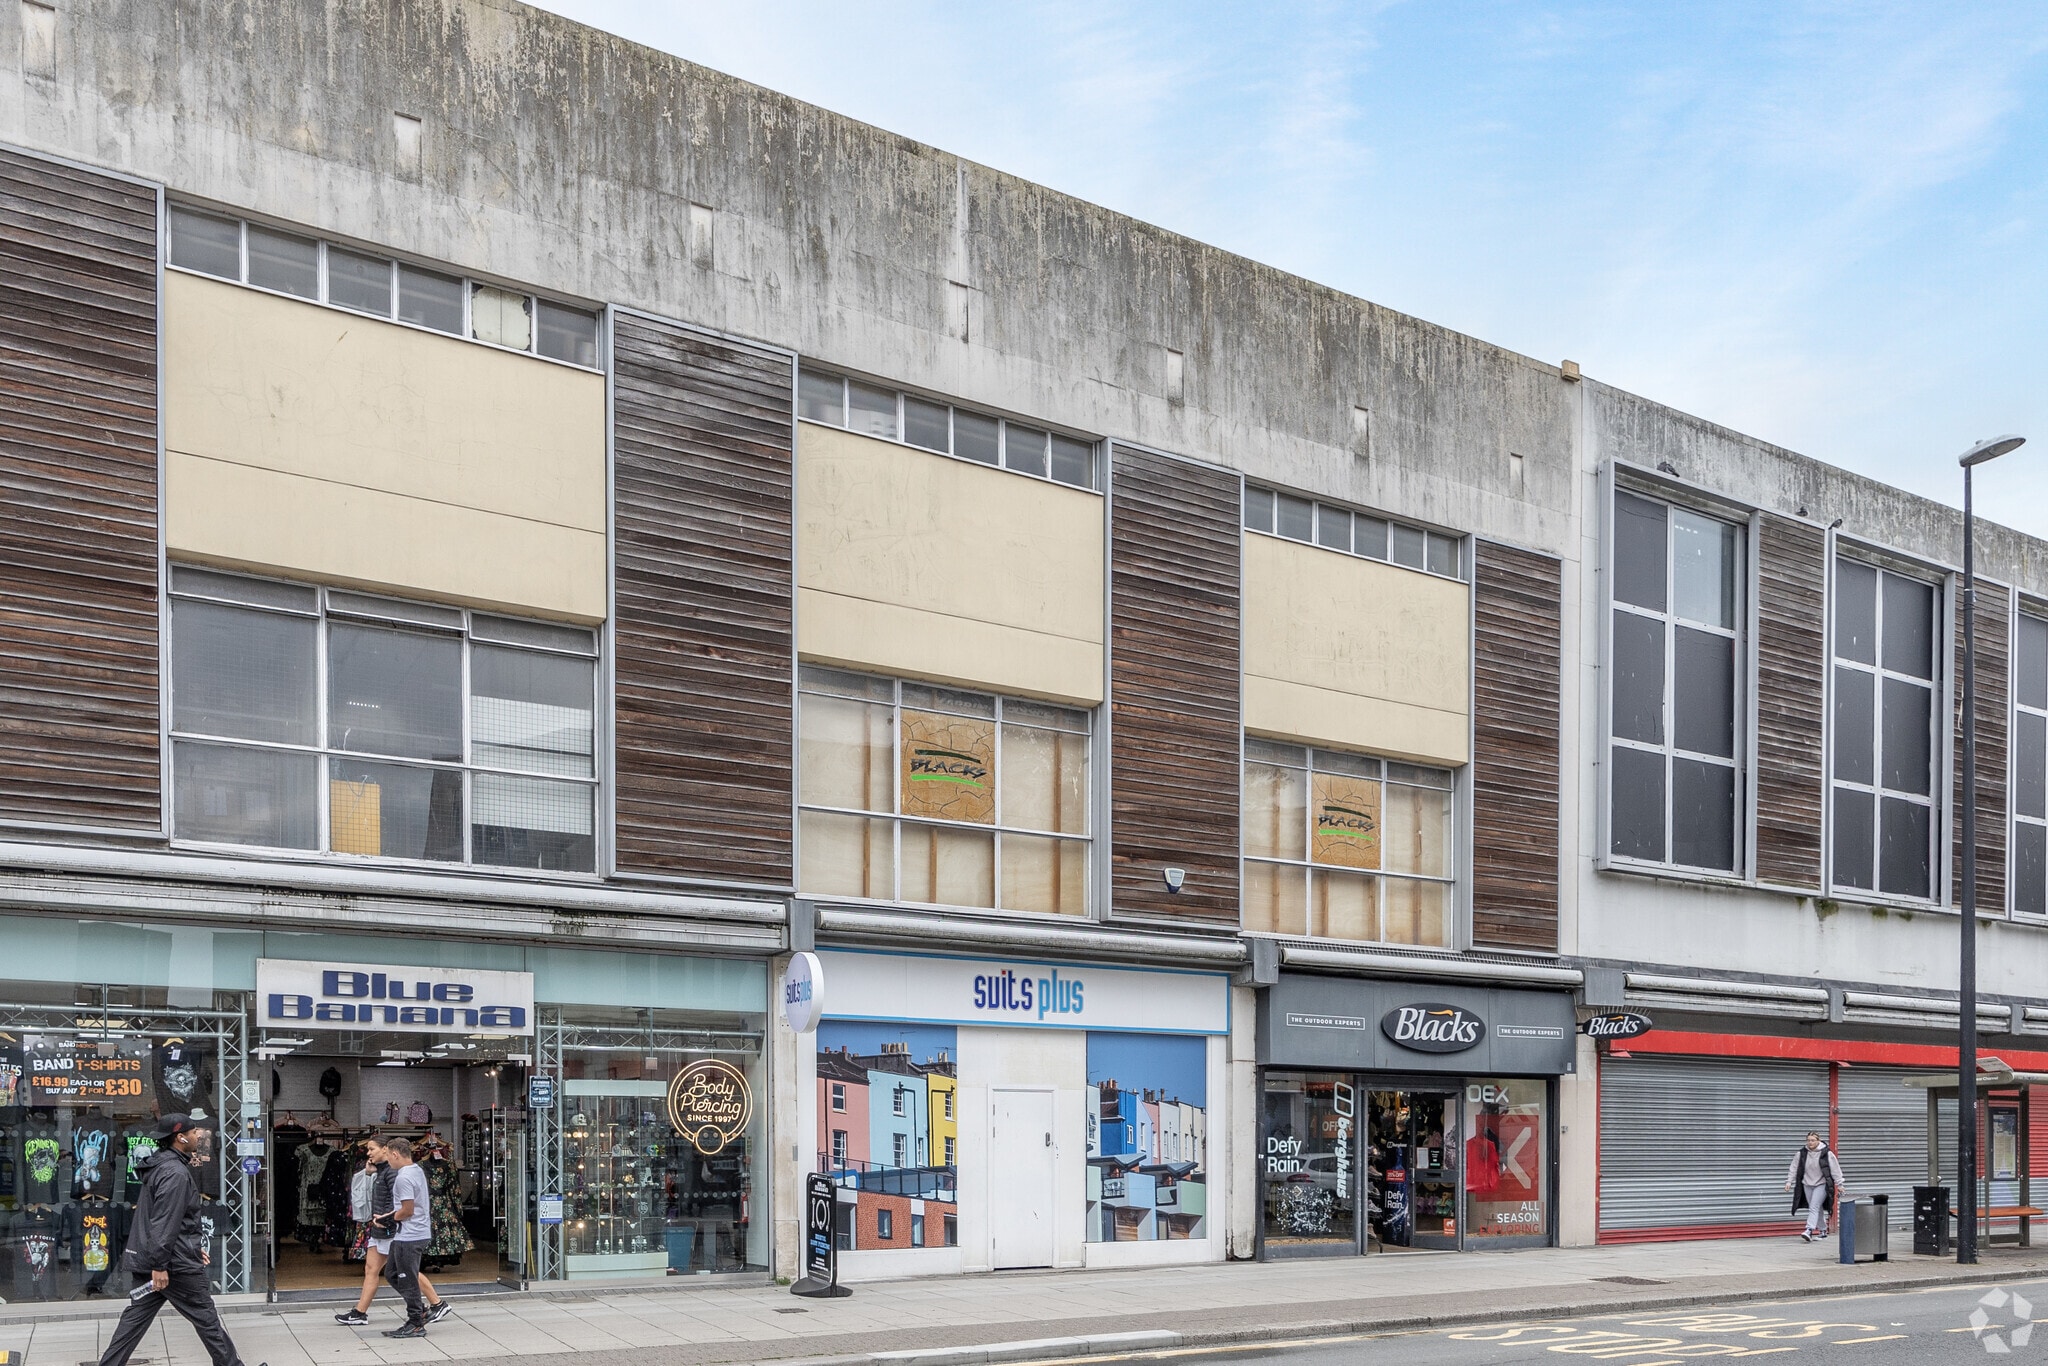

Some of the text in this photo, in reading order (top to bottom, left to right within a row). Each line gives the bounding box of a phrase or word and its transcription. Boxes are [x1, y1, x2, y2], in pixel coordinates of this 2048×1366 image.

[910, 759, 987, 779] BLACKS
[322, 970, 474, 1002] Blue
[974, 968, 1084, 1020] suits plus
[268, 993, 526, 1027] Banana
[1304, 1017, 1333, 1025] OUTDOOR
[1394, 1007, 1480, 1043] Blacks
[1588, 1016, 1640, 1036] Blacks
[1512, 1028, 1536, 1036] OUTDOOR
[33, 1058, 141, 1071] BAND T-SHIRTS
[32, 1076, 69, 1087] £16.99
[70, 1079, 92, 1087] EACH
[46, 1087, 60, 1095] BUY
[62, 1087, 77, 1095] ANY
[80, 1087, 87, 1096] 2
[105, 1078, 142, 1096] £30
[689, 1073, 735, 1101] Body
[680, 1093, 741, 1120] Piercing
[687, 1114, 732, 1123] SINCE 1997
[1267, 1136, 1302, 1157] Defy
[1267, 1156, 1303, 1173] Rain.
[1335, 1117, 1351, 1199] berghaus
[1387, 1190, 1404, 1201] Defy
[1520, 1201, 1540, 1211] ALL
[1497, 1212, 1539, 1223] SEASON
[1621, 1313, 1881, 1339] BUS
[1447, 1326, 1750, 1359] STOP
